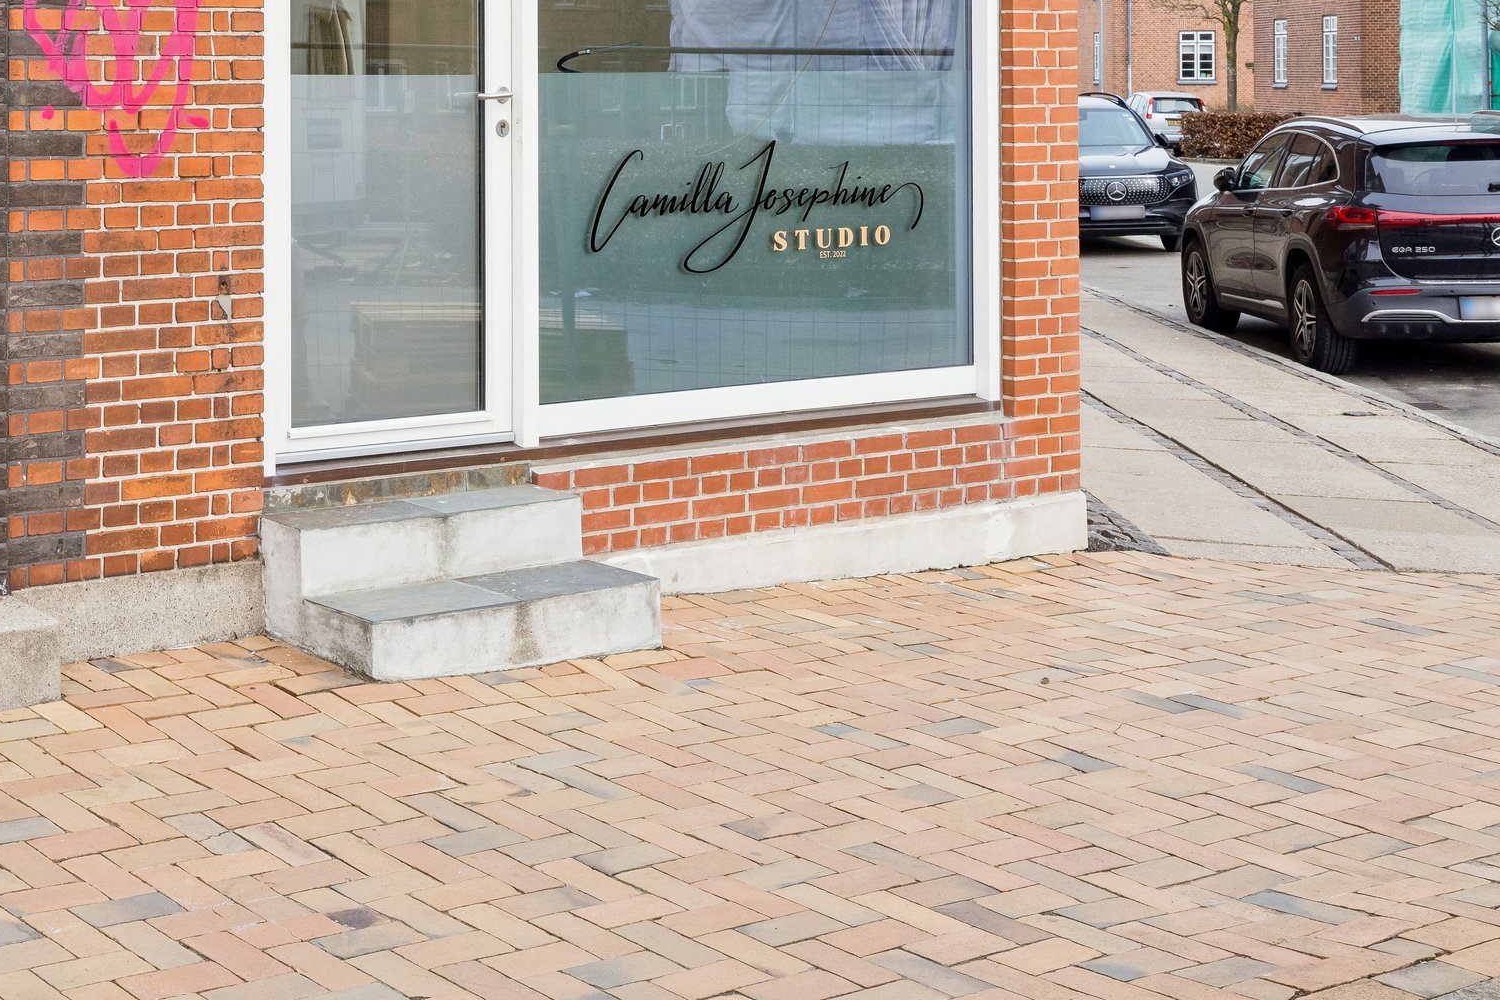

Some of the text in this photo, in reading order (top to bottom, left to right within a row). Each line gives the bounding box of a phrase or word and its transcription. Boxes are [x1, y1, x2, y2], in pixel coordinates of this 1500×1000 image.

[590, 139, 924, 274] Camilla Josephine
[773, 224, 891, 252] STUDIO
[819, 250, 847, 259] EST. 2022
